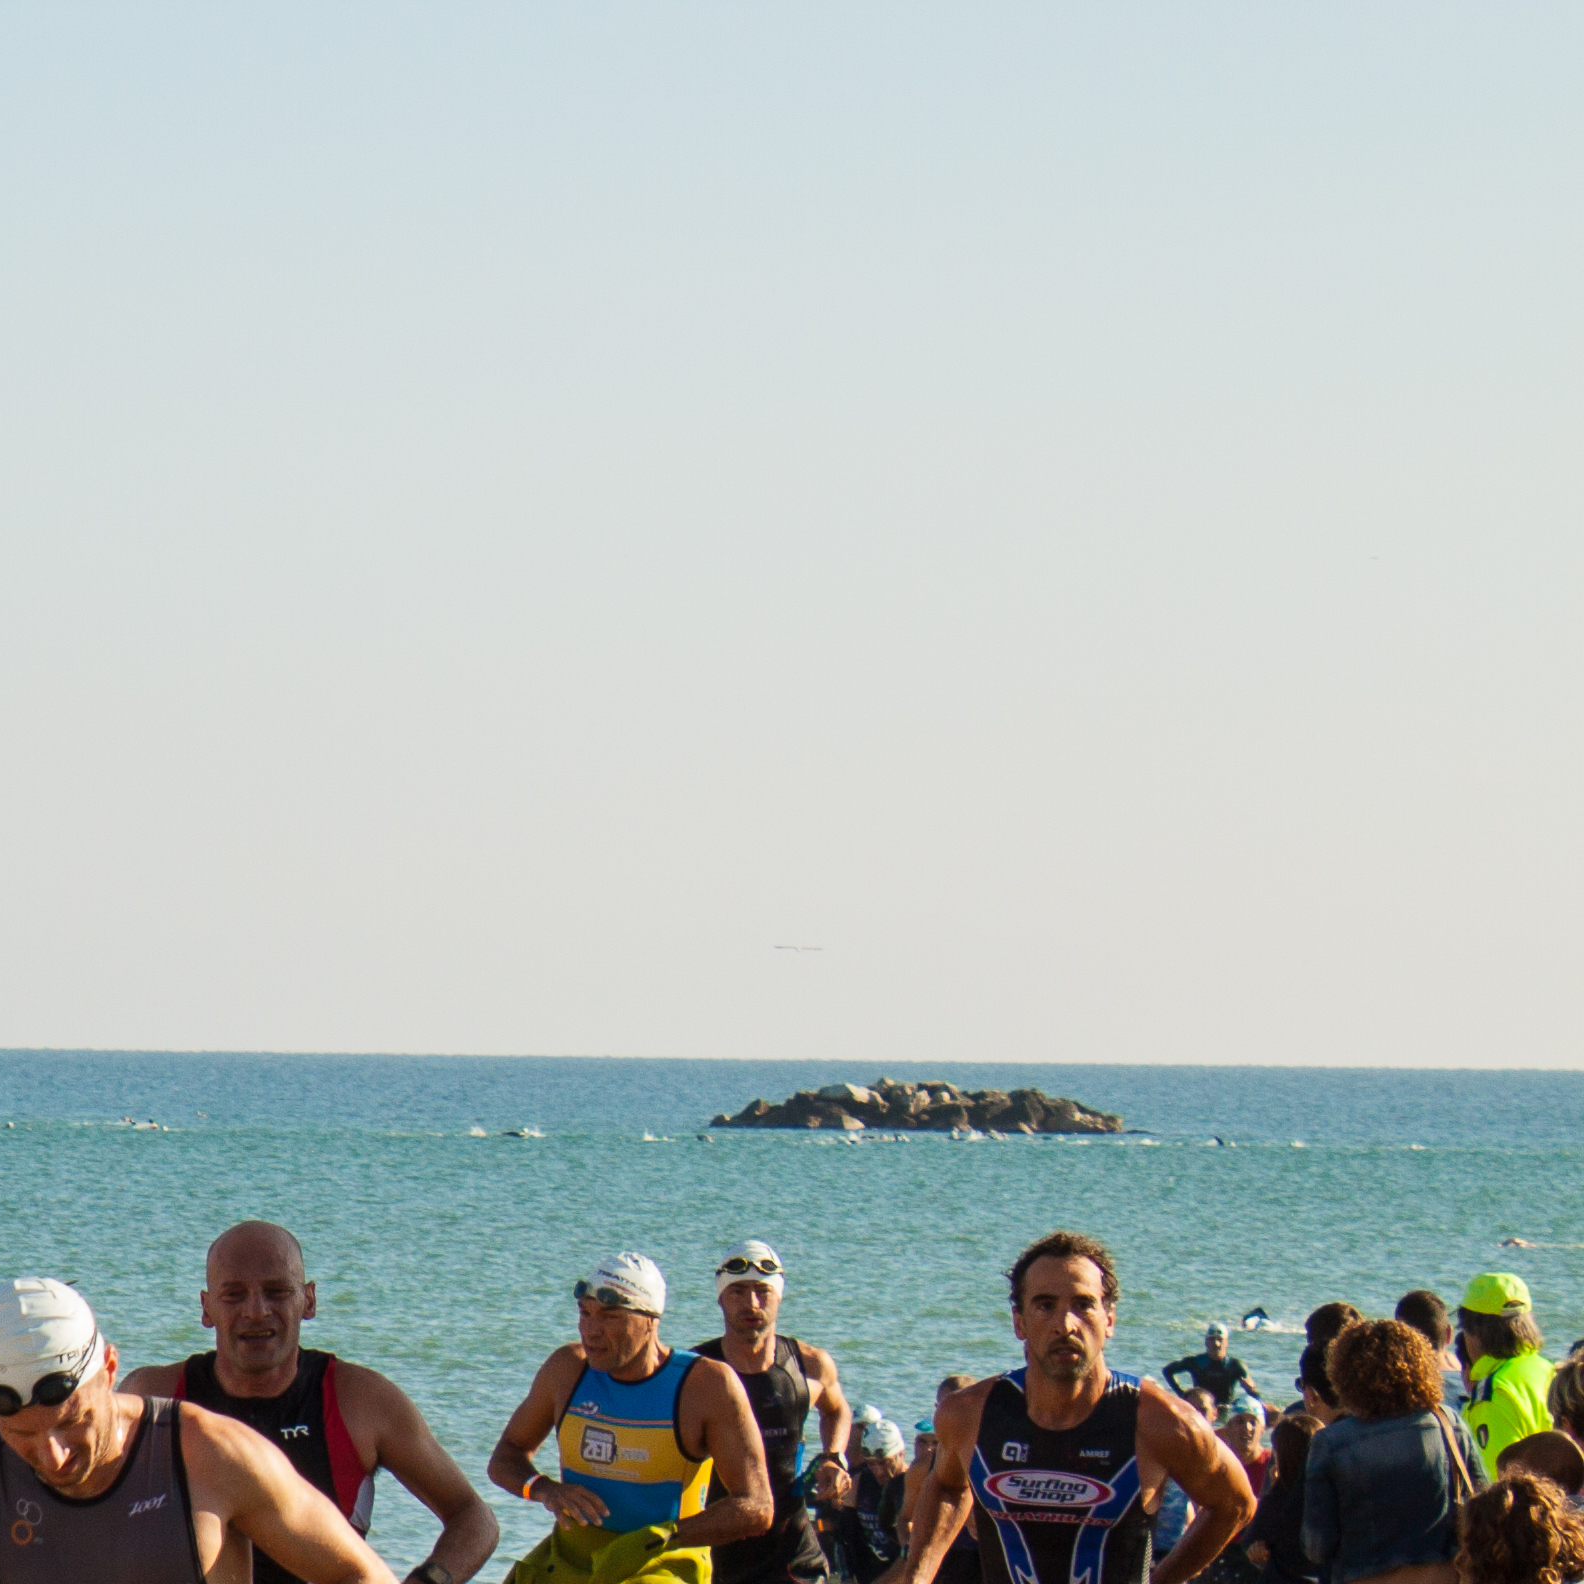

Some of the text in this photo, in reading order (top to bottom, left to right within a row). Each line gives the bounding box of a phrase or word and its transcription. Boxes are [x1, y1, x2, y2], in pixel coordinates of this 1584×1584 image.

[280, 1425, 310, 1440] TYR
[1008, 1476, 1088, 1495] Surfing
[1018, 1488, 1076, 1503] Shop
